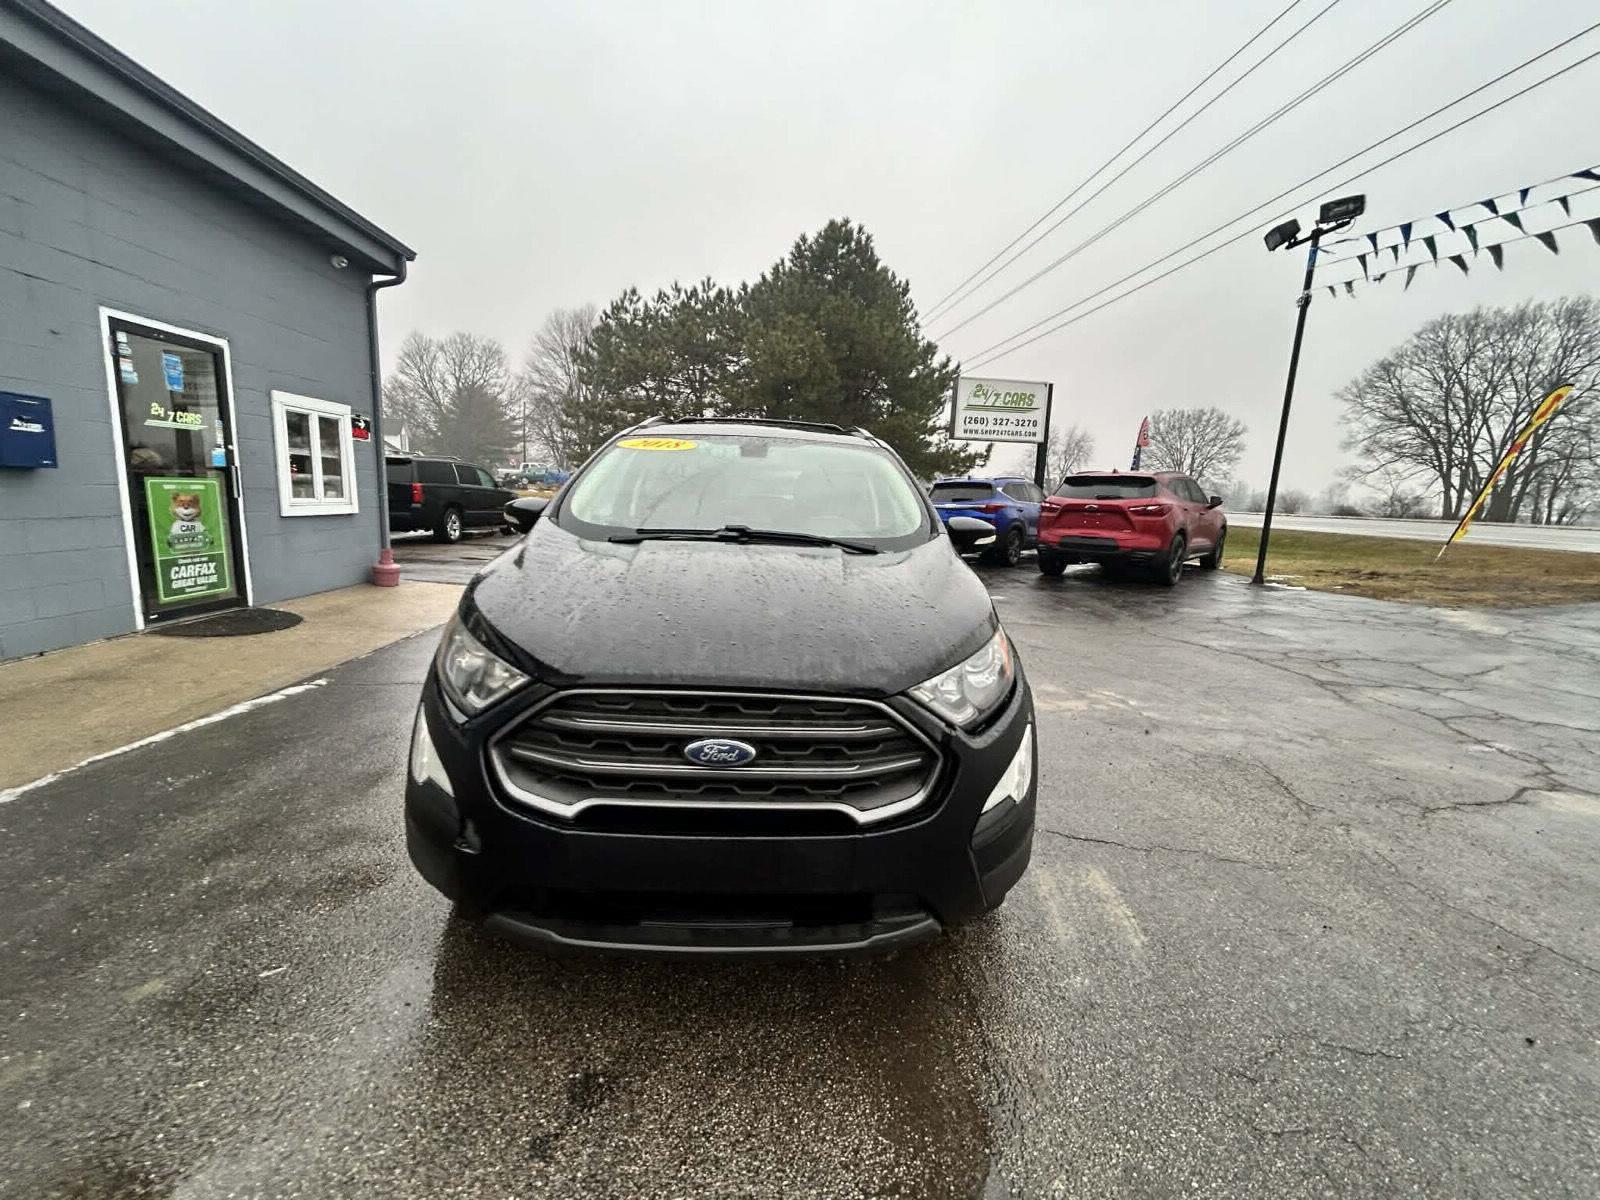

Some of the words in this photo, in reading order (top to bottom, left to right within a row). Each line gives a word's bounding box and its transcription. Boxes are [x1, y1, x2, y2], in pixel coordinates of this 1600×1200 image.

[974, 384, 1002, 406] 24/7
[1003, 392, 1036, 407] CARS
[151, 402, 175, 422] 247
[176, 411, 202, 425] CARS
[963, 416, 989, 427] (260)
[993, 417, 1038, 428] 327-3270
[963, 428, 1037, 437] WWW.SHOP247CARS.COM
[171, 562, 217, 580] CARFAX
[700, 744, 739, 761] Ford
